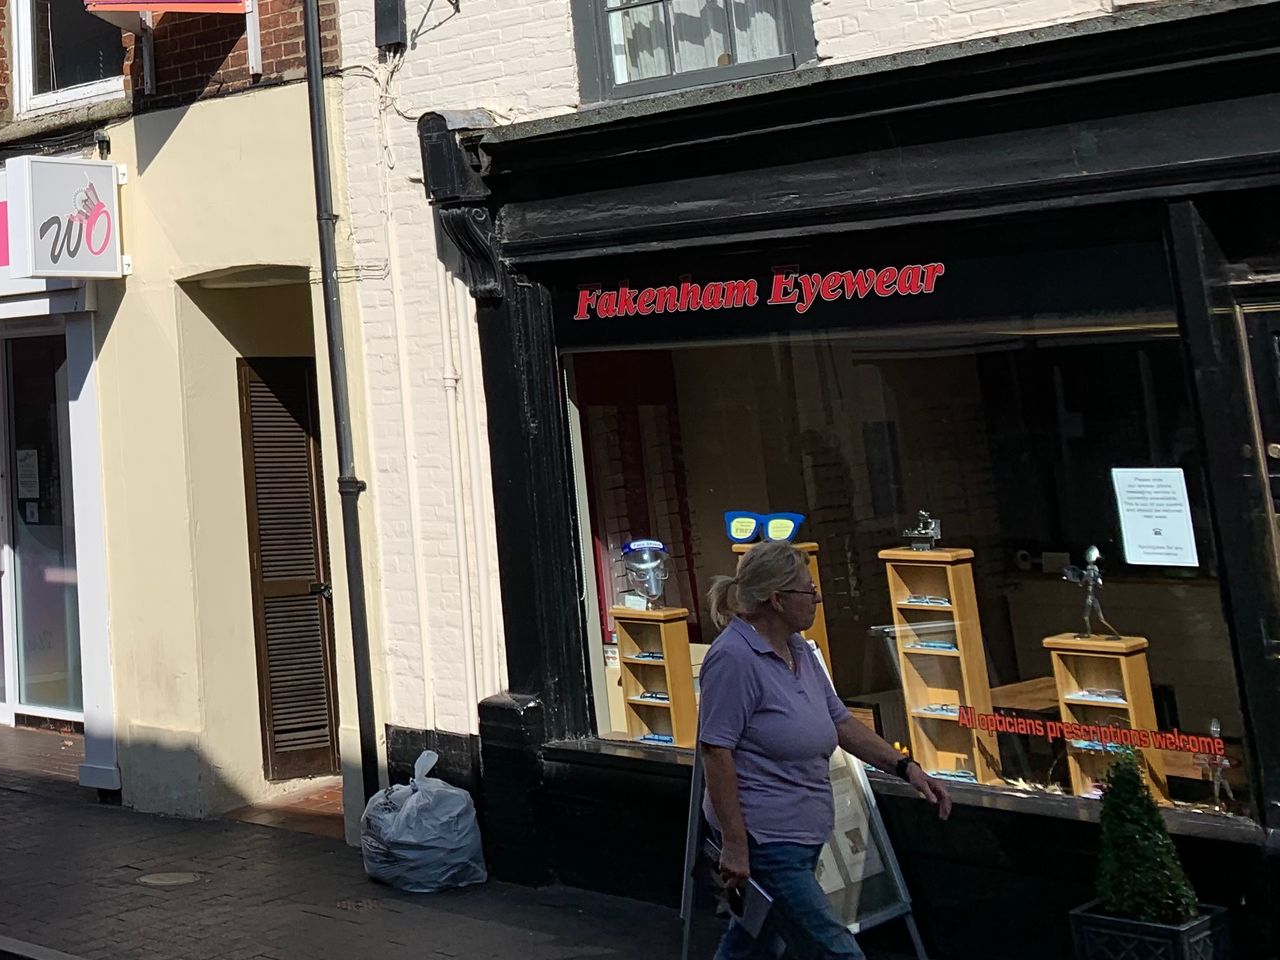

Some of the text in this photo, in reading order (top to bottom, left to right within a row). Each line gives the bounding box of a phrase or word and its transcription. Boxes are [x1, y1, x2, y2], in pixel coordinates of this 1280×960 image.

[573, 262, 945, 321] Fakenham Eyewear
[958, 706, 1226, 756] All opticians prescriptions welcome
